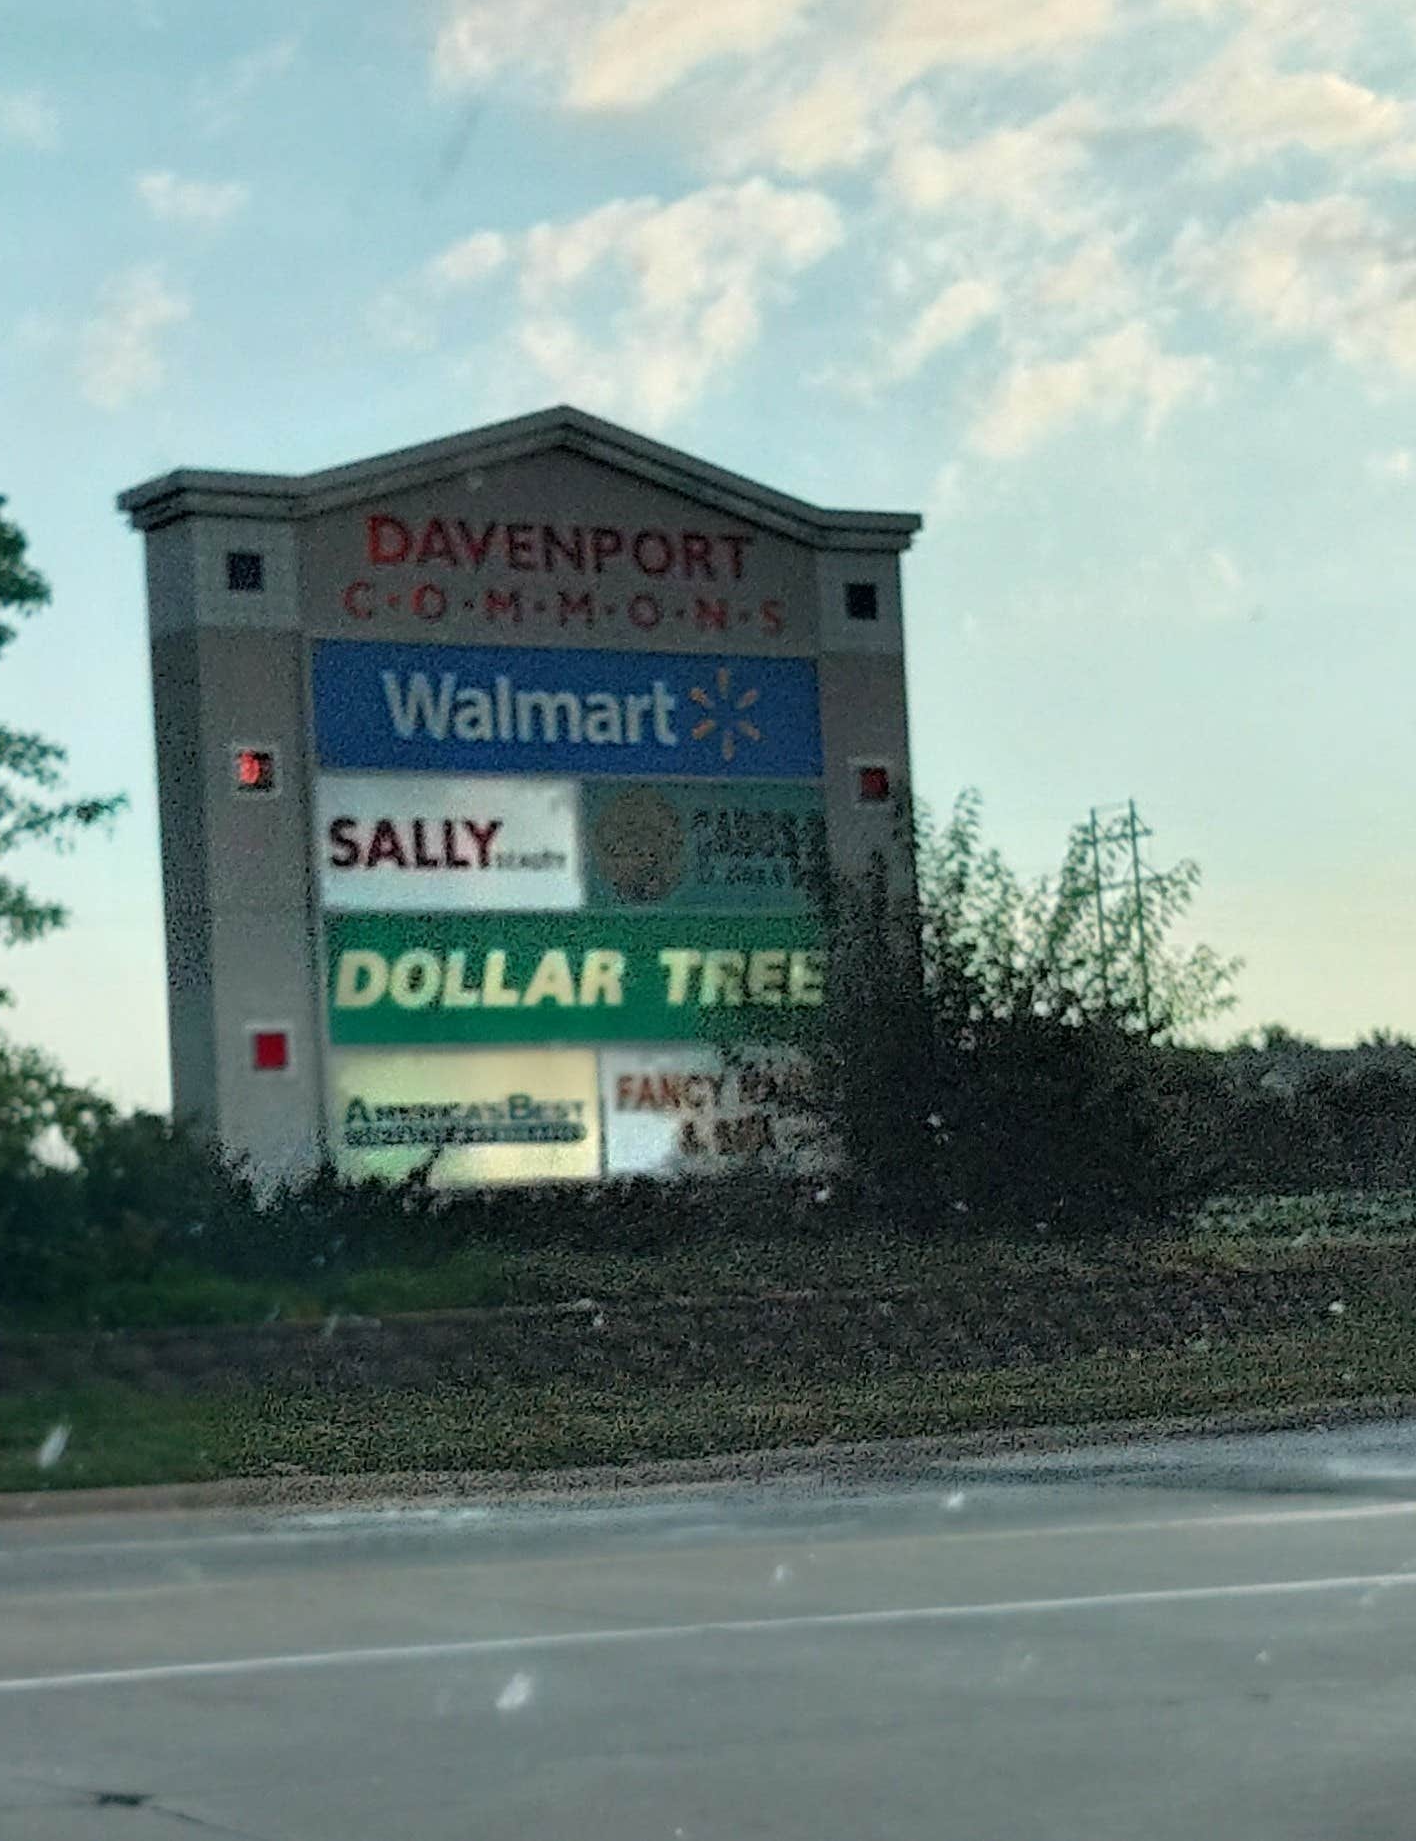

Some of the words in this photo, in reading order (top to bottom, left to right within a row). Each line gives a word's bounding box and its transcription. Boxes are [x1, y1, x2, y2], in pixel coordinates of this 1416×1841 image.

[367, 514, 752, 580] DAVENPORT
[384, 670, 678, 746] Walmart
[329, 817, 503, 870] SALLY
[334, 949, 626, 1007] DOLLAR
[659, 950, 824, 1007] TREE
[616, 1073, 724, 1111] FANCY
